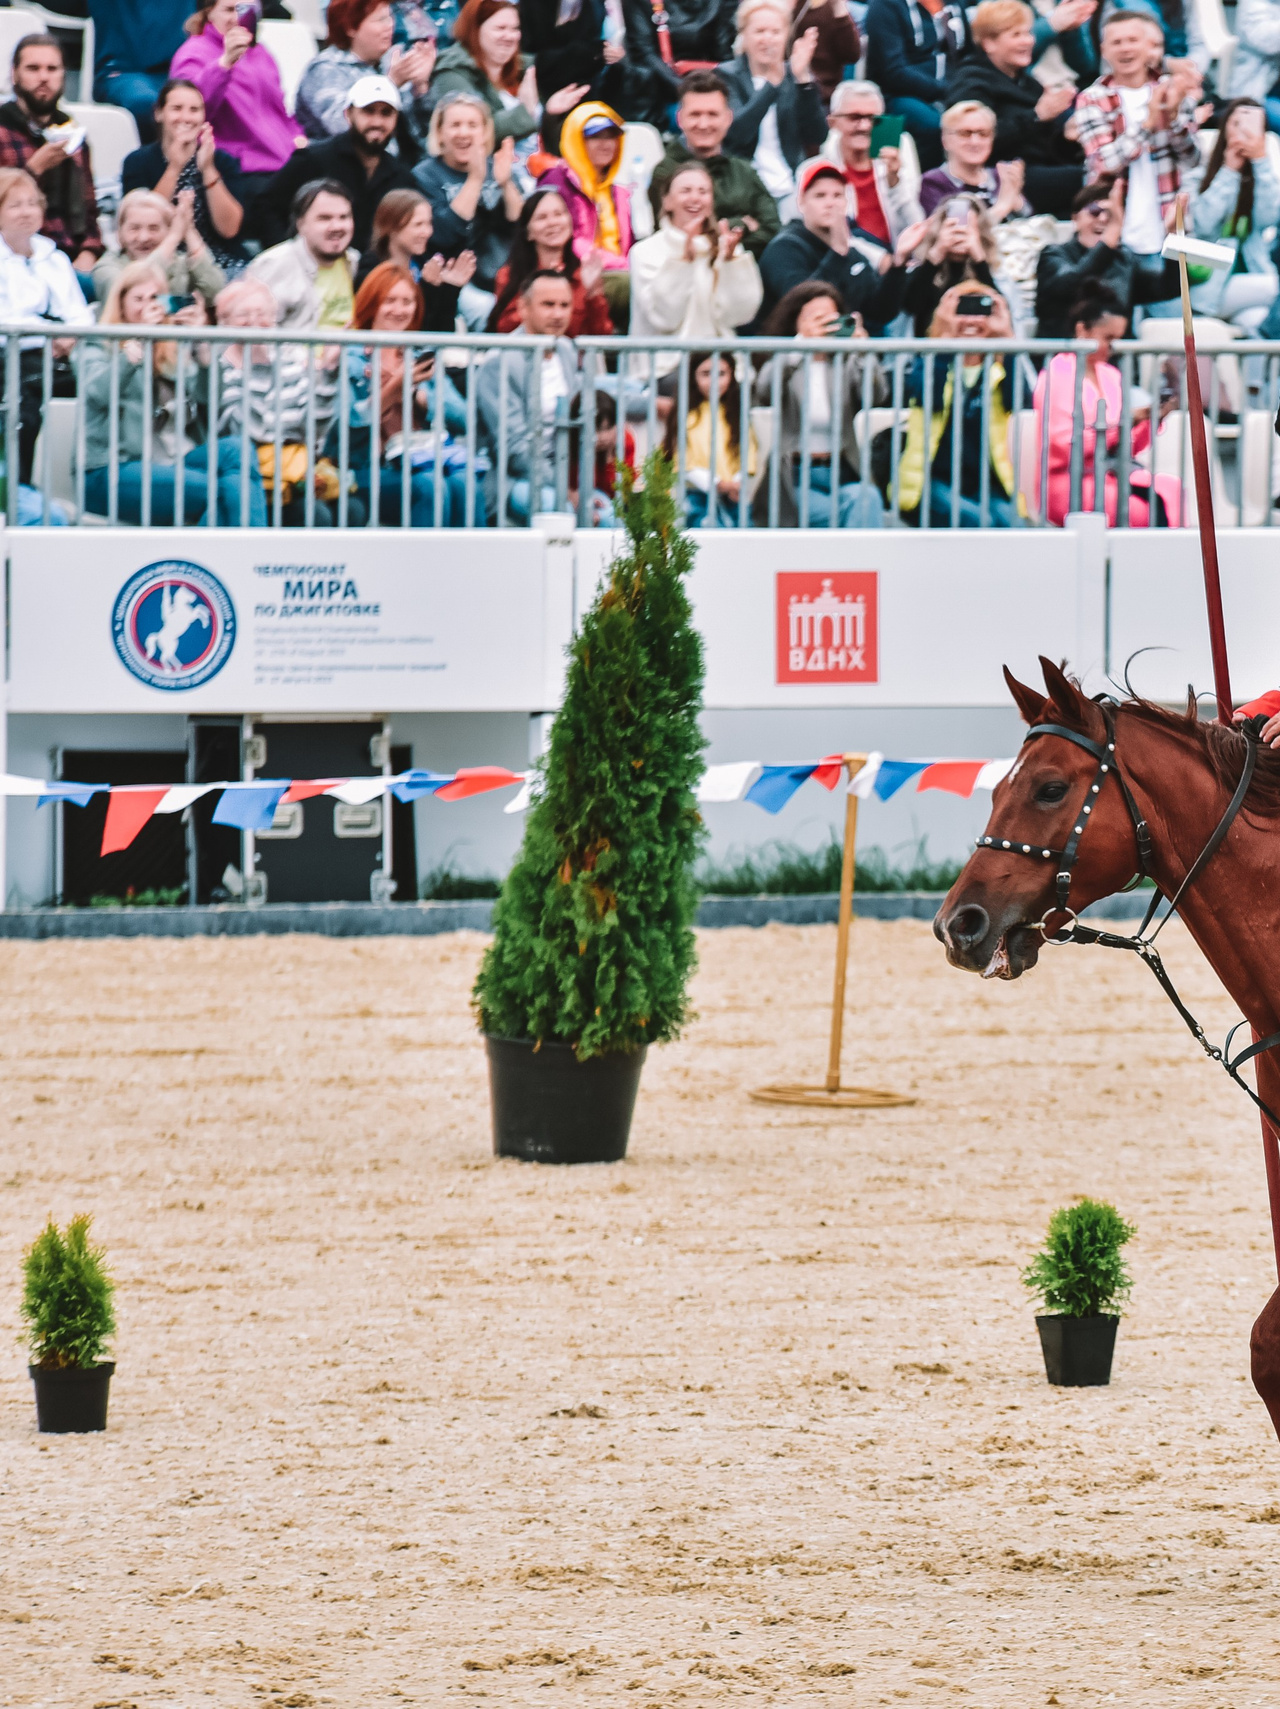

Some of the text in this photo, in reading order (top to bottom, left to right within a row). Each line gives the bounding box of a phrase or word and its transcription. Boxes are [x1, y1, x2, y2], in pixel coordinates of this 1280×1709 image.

[254, 563, 346, 577] ЧЕМПИОНАТ
[283, 579, 358, 600] МИРА
[254, 603, 382, 618] ПО ДЖИГИТОВКЕ
[789, 647, 866, 671] ВДНХ
